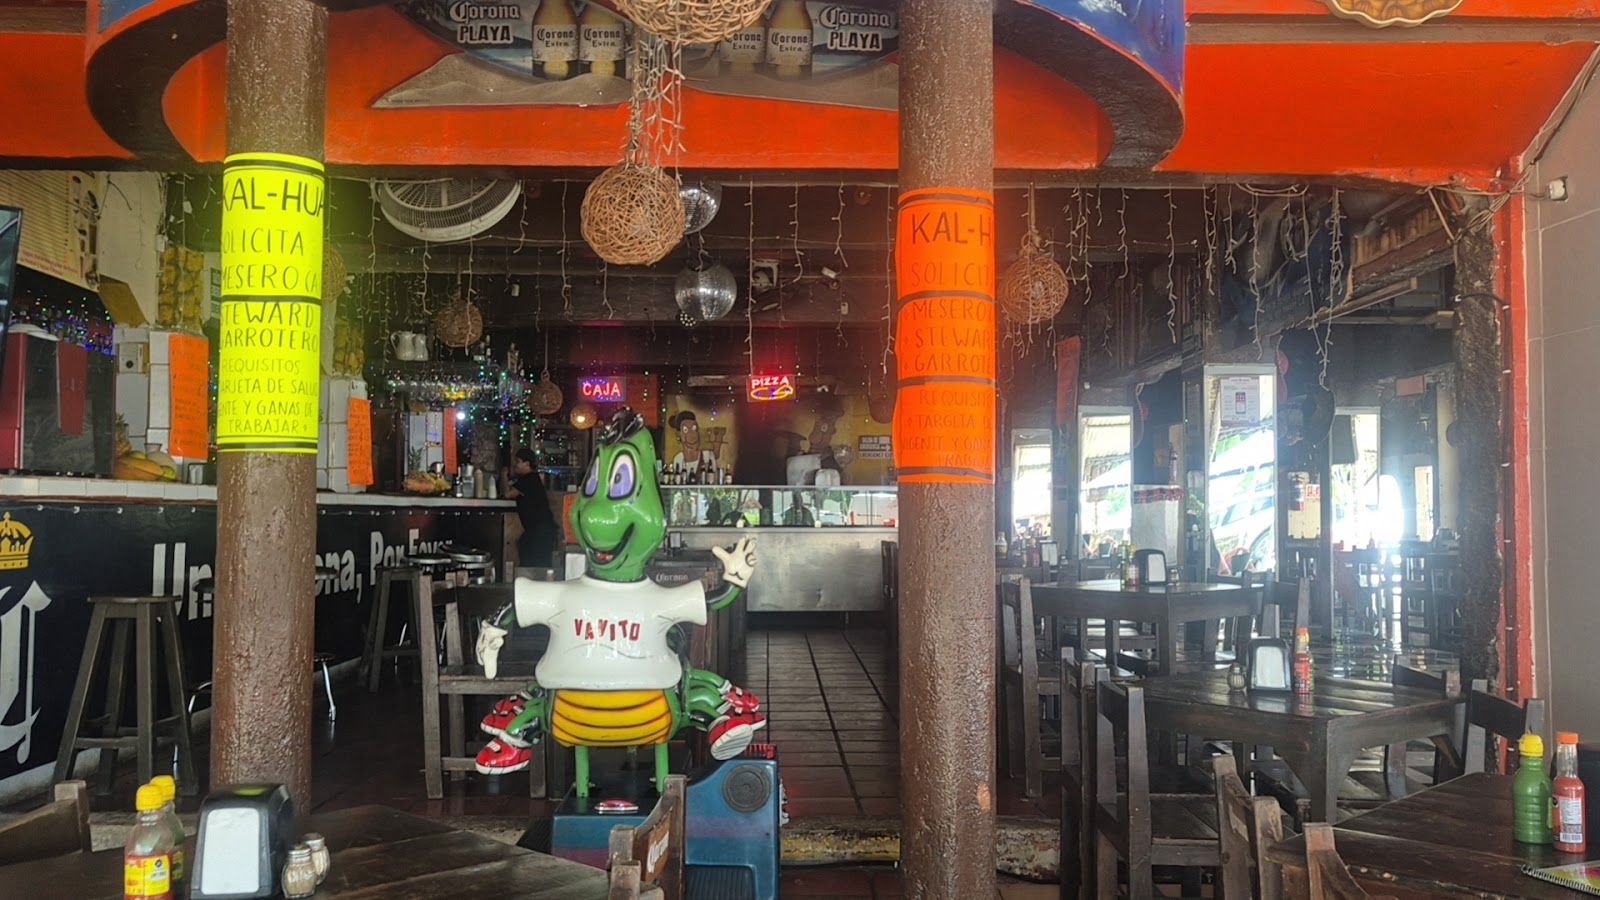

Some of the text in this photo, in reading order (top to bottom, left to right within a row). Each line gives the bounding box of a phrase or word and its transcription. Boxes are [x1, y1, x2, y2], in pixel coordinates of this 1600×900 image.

[450, 1, 520, 24] Corona
[820, 7, 890, 30] Corona
[458, 25, 513, 43] PLAYA
[537, 28, 574, 44] Corona
[584, 28, 621, 44] Corona
[772, 32, 808, 46] Corona
[829, 31, 882, 50] PLAYA
[267, 378, 285, 393] DE
[582, 382, 620, 397] CAJA
[752, 376, 789, 389] PIZZA
[243, 400, 252, 415] Y
[257, 400, 301, 416] GANAS
[227, 418, 300, 434] TRABAJAR
